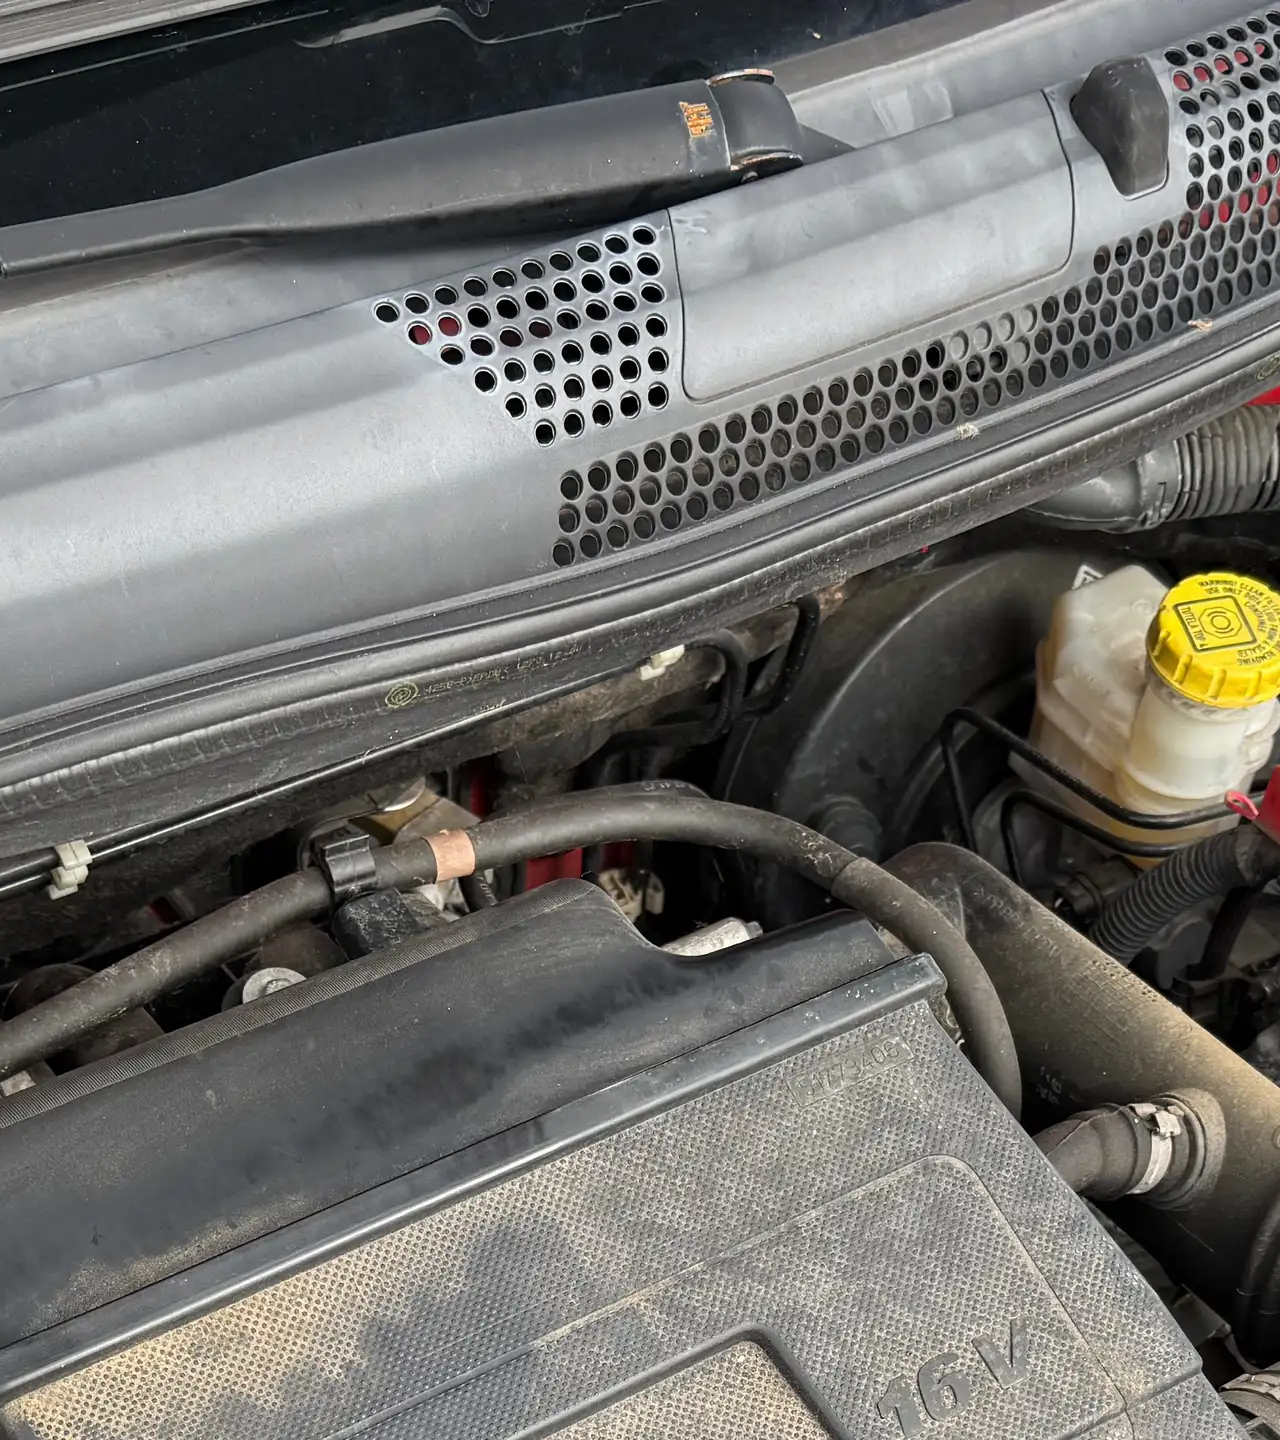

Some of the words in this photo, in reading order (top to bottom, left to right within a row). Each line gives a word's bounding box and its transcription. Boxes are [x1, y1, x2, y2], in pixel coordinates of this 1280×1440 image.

[1204, 587, 1221, 596] USE
[1239, 582, 1265, 597] CLEAN
[1178, 605, 1199, 631] TUTELA
[1192, 629, 1208, 643] TOP
